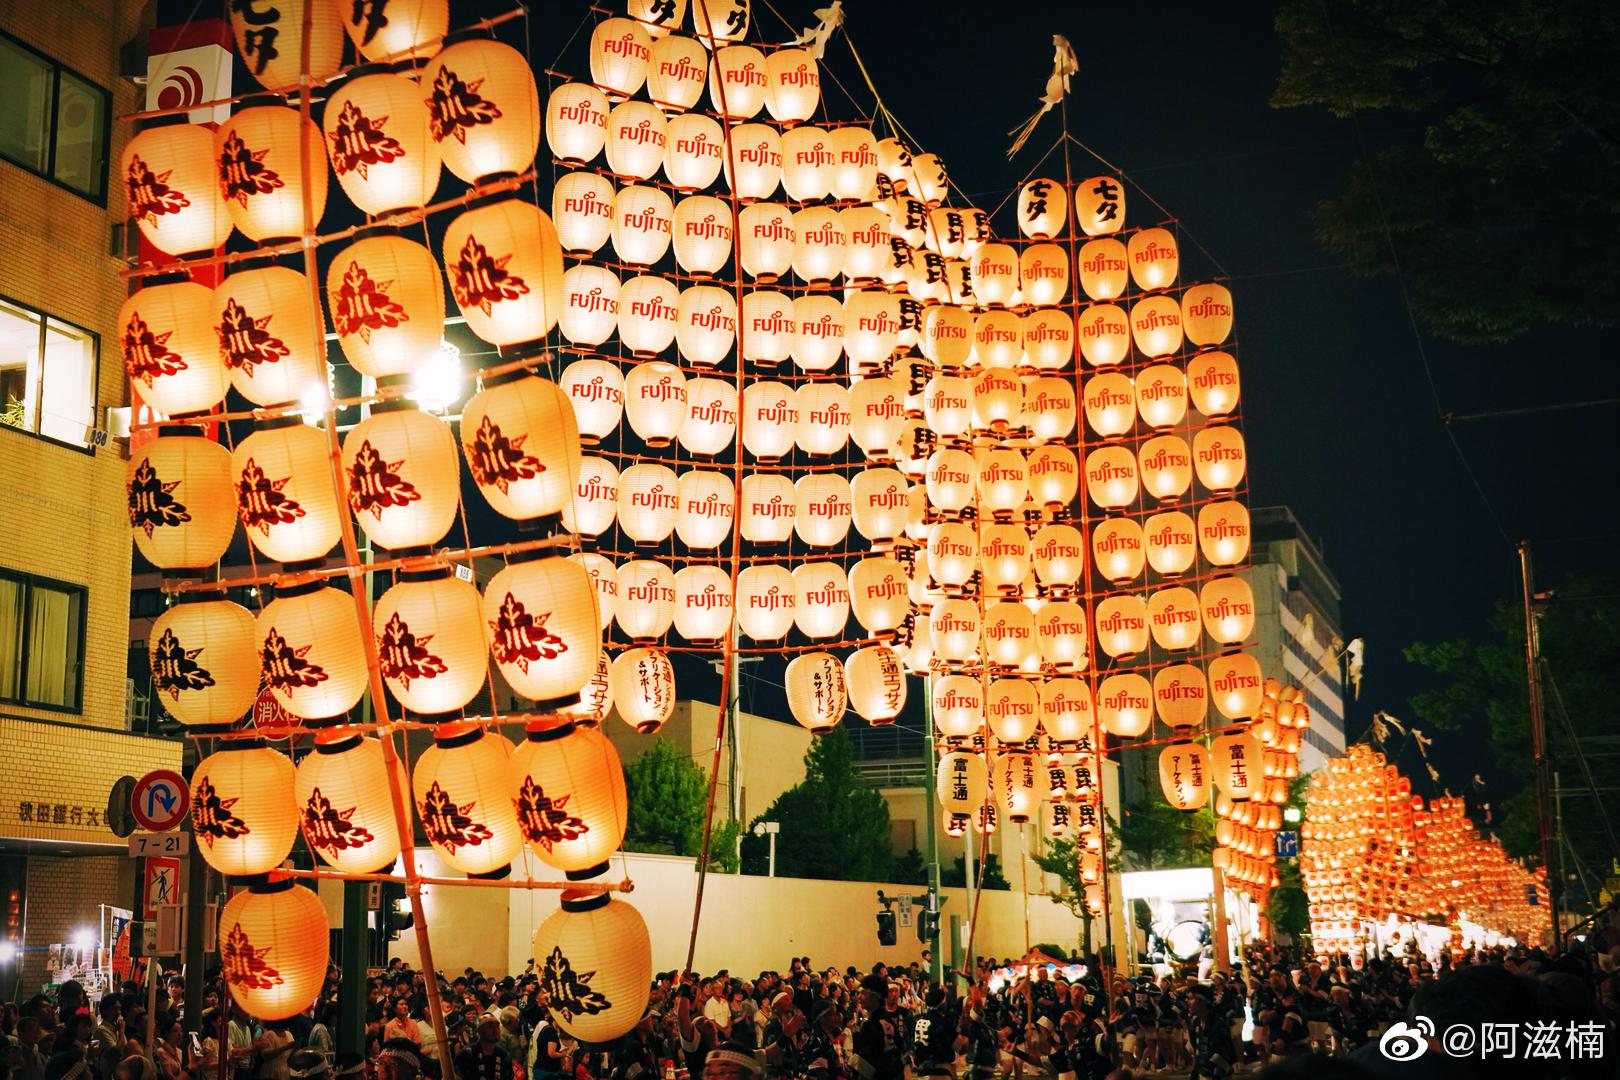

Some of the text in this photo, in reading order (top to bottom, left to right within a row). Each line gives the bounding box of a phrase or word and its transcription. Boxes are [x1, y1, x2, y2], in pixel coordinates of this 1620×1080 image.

[1027, 181, 1052, 222] 七夕
[1092, 180, 1118, 223] 七夕
[1136, 242, 1176, 264] FUJITSU
[1023, 261, 1064, 282] FUJITSU
[1083, 253, 1125, 275] FUJITSU
[1189, 297, 1231, 318] FUJITSU
[1083, 317, 1125, 338] FUJITSU
[1136, 310, 1179, 331] FUJITSU
[976, 324, 1017, 344] FUJITSU
[1027, 323, 1069, 343] FUJITSU
[975, 375, 1017, 396] FUJITSU
[1194, 367, 1237, 389] FUJITSU
[1089, 388, 1131, 410] FUJITSU
[1141, 380, 1183, 401] FUJITSU
[1028, 393, 1070, 413] FUJITSU
[1144, 449, 1188, 471] FUJITSU
[1199, 442, 1242, 463] FUJITSU
[980, 463, 1023, 484] FUJITSU
[1029, 455, 1073, 476] FUJITSU
[1090, 462, 1133, 483] FUJITSU
[1149, 527, 1192, 548] FUJITSU
[1204, 519, 1247, 541] FUJITSU
[982, 538, 1024, 559] FUJITSU
[1036, 539, 1079, 560] FUJITSU
[1097, 532, 1140, 554] FUJITSU
[1153, 605, 1197, 626] FUJITSU
[1206, 598, 1251, 620] FUJITSU
[986, 620, 1029, 641] FUJITSU
[1039, 616, 1083, 637] FUJITSU
[1100, 612, 1144, 634] FUJITSU
[1158, 680, 1204, 702] FUJITSU
[1214, 671, 1260, 692] FUJITSU
[990, 696, 1033, 718] FUJITSU
[1044, 693, 1088, 715] FUJITSU
[1105, 690, 1148, 711] FUJITSU
[1021, 756, 1034, 789] 富士通
[1190, 753, 1203, 787] 富士通
[1229, 744, 1248, 788] 富士通
[952, 758, 969, 801] 富士通
[20, 801, 110, 827] 秋田銀行大
[138, 837, 181, 854] 7-21
